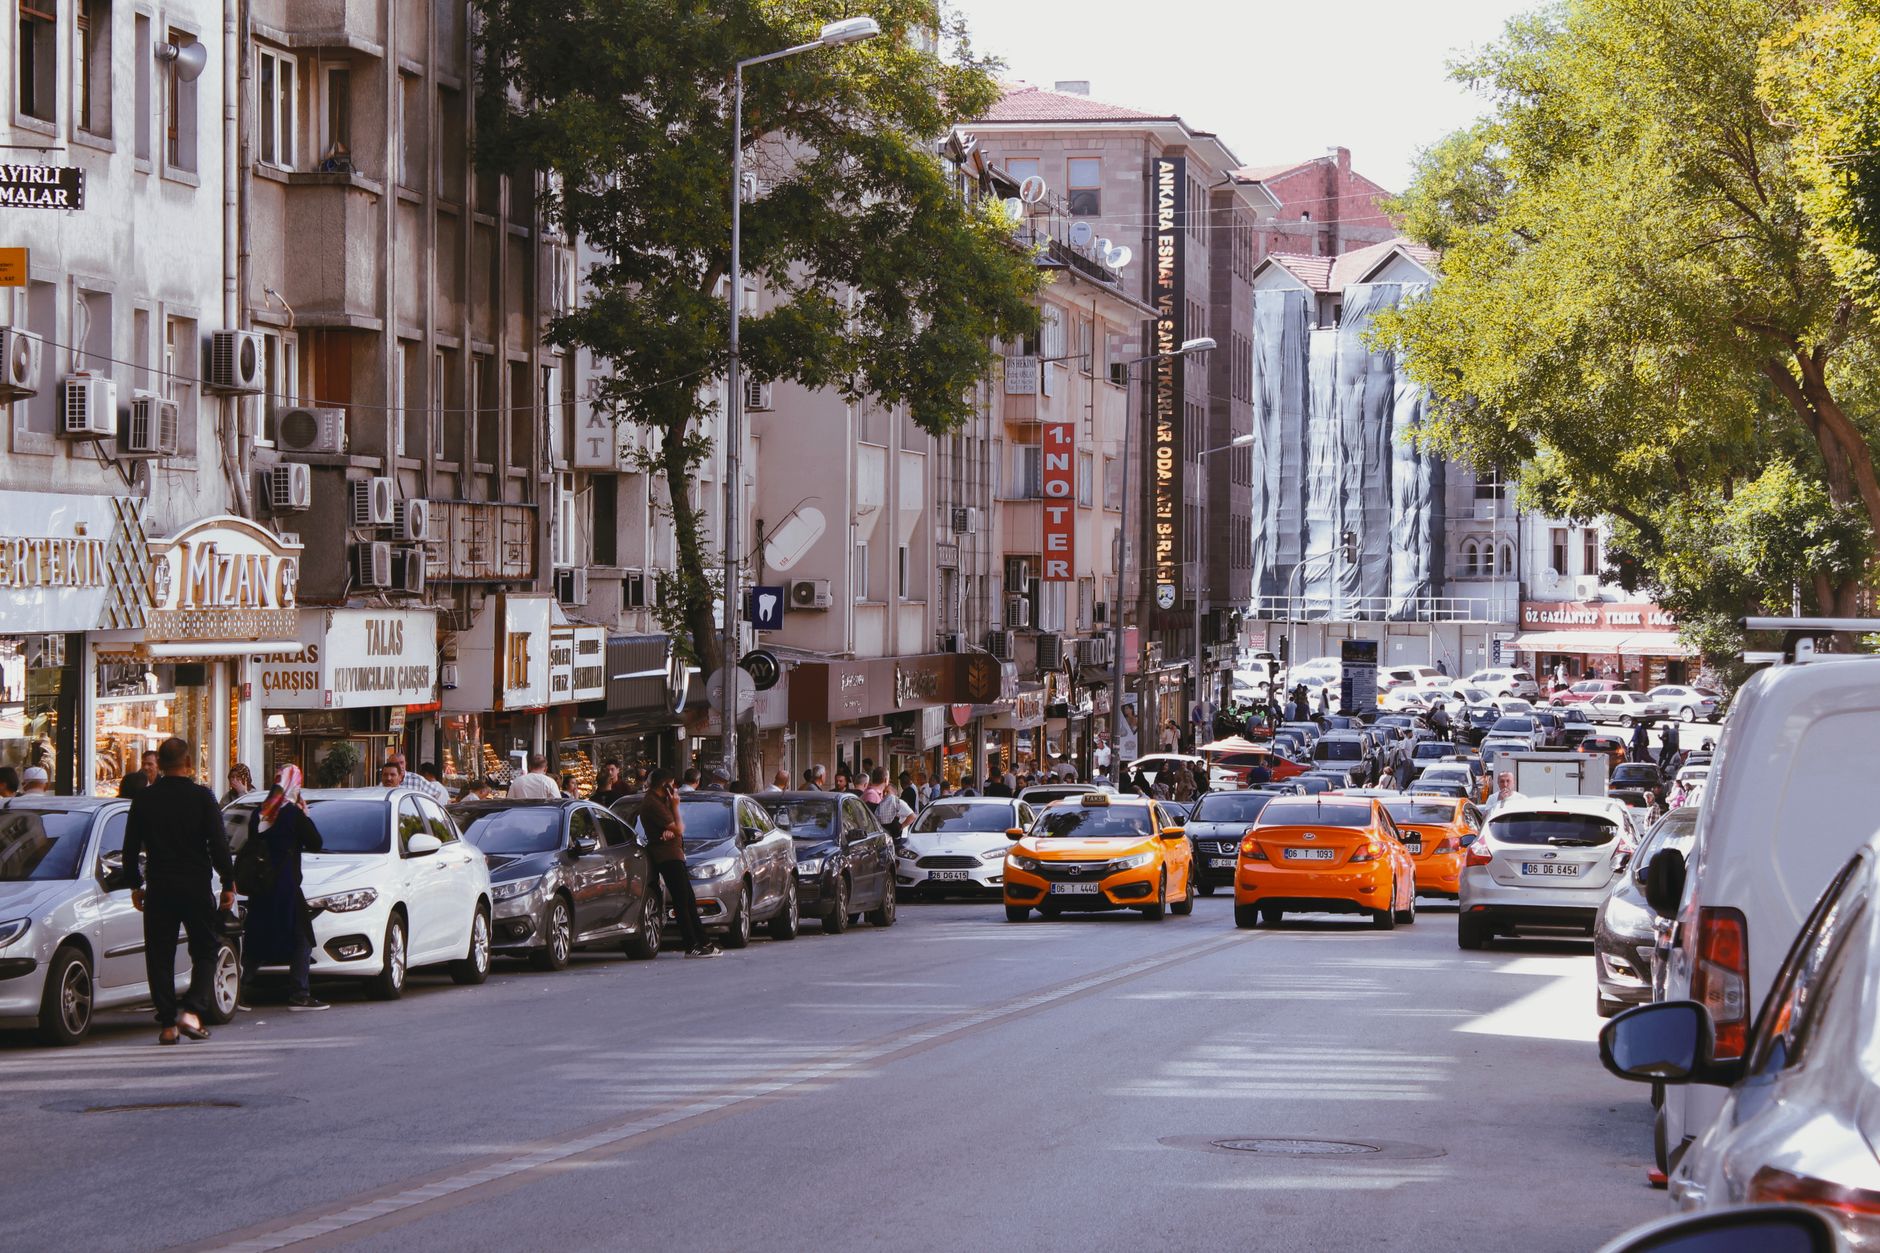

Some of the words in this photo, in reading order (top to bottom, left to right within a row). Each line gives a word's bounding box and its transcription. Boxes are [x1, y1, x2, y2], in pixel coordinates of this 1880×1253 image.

[1158, 161, 1175, 231] ANKARA
[1158, 235, 1174, 289] ESNAF
[1048, 426, 1072, 444] 1.
[1045, 452, 1070, 578] NOTER
[1525, 607, 1539, 623] ÖZ
[365, 619, 404, 656] TALAS
[262, 671, 319, 696] ÇARŞISI
[334, 666, 395, 693] KUYUMCULAR
[398, 665, 429, 695] ÇARŞISI
[1288, 849, 1298, 858] 06
[1304, 850, 1309, 858] T
[1316, 850, 1333, 859] 1093
[1527, 864, 1538, 873] 06
[1543, 864, 1554, 874] DG
[1556, 865, 1577, 875] 6454
[1056, 885, 1065, 893] 06
